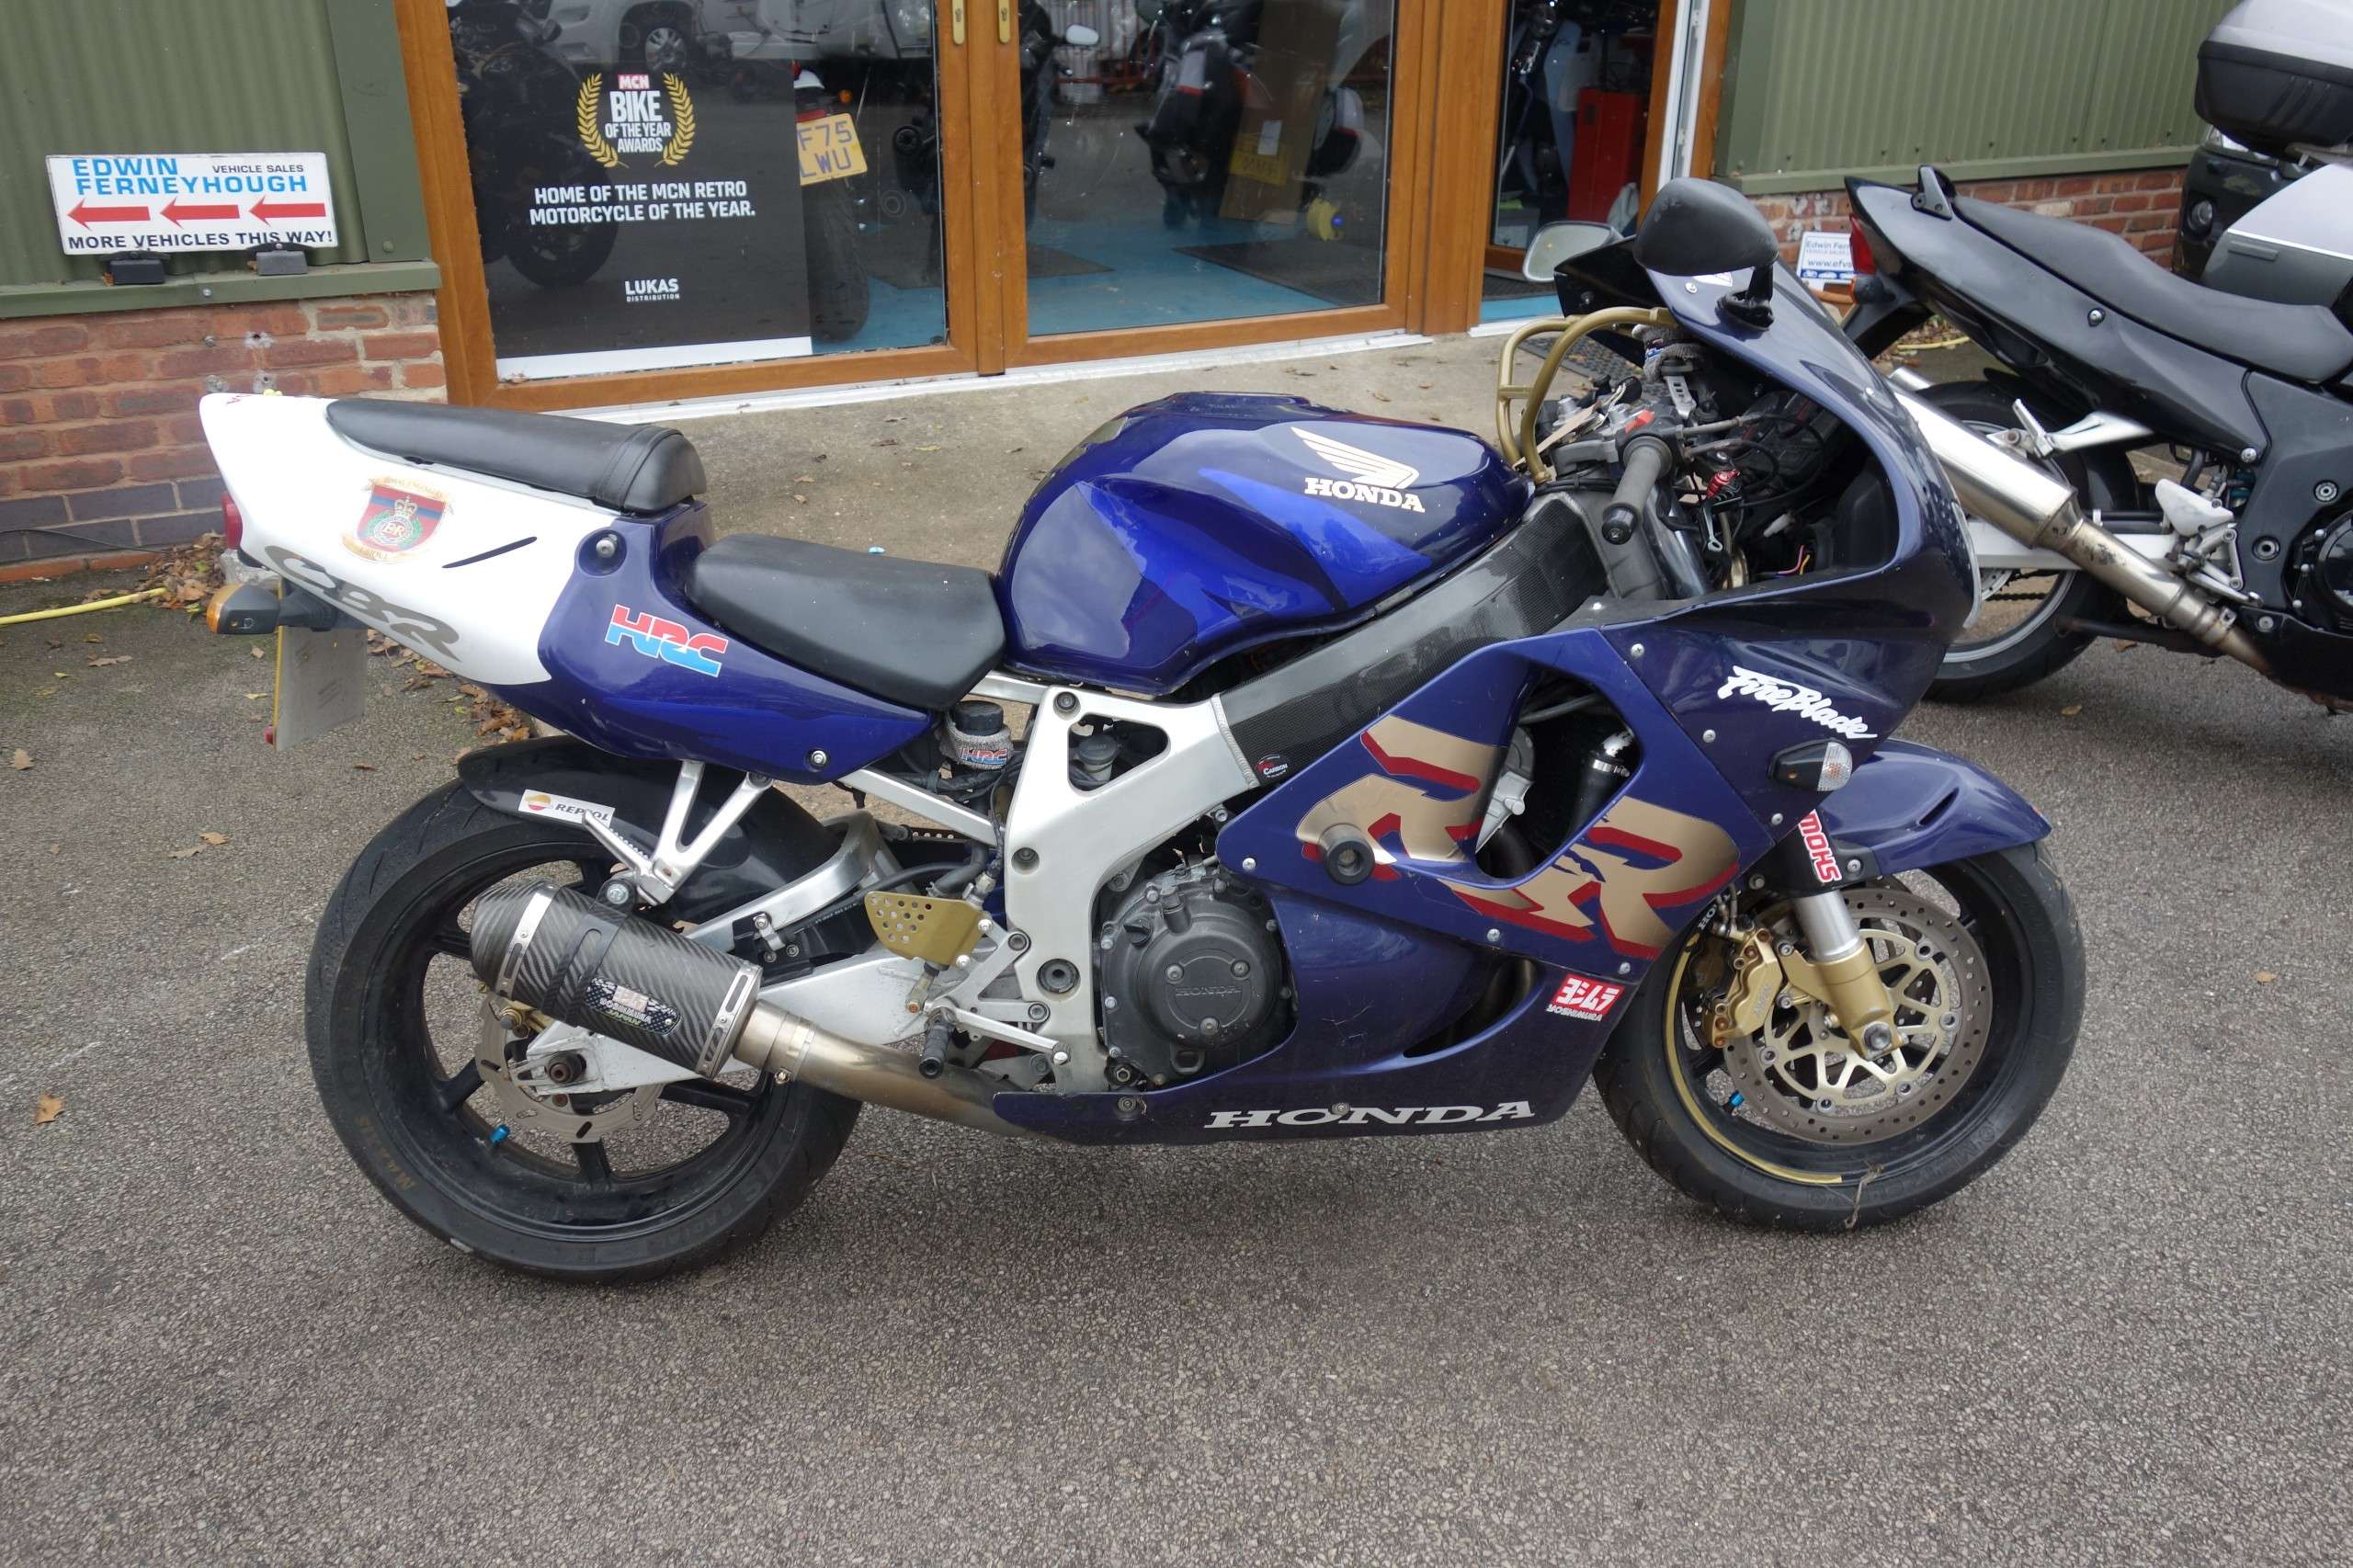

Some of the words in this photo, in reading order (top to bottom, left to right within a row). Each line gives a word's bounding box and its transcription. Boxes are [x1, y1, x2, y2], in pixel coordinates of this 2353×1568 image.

[620, 74, 650, 89] MCN
[609, 90, 663, 122] BIKE
[605, 123, 620, 138] OF
[621, 123, 642, 137] THE
[642, 122, 672, 137] YEAR
[618, 138, 663, 153] AWARDS
[73, 158, 178, 176] EDWIN
[212, 165, 262, 174] VEHICLE
[267, 165, 304, 173] SALES
[75, 176, 307, 196] FERNEYHOUGH
[534, 187, 586, 204] HOME
[589, 186, 611, 202] OF
[614, 185, 648, 200] THE
[652, 182, 690, 199] MCN
[694, 181, 746, 198] RETRO
[529, 204, 644, 225] MOTORCYCLE
[648, 204, 670, 220] OF
[673, 202, 705, 220] THE
[708, 200, 756, 218] YEAR.
[68, 235, 127, 249] MORE
[131, 233, 230, 248] VEHICLES
[235, 232, 280, 244] THIS
[286, 231, 333, 244] WAY!
[625, 278, 679, 295] LUKAS
[626, 294, 680, 302] DISTRIBUTION
[1304, 477, 1426, 514] HONDA
[265, 545, 461, 662] CBR
[605, 604, 728, 678] HRC
[1204, 1100, 1536, 1129] HONDA
